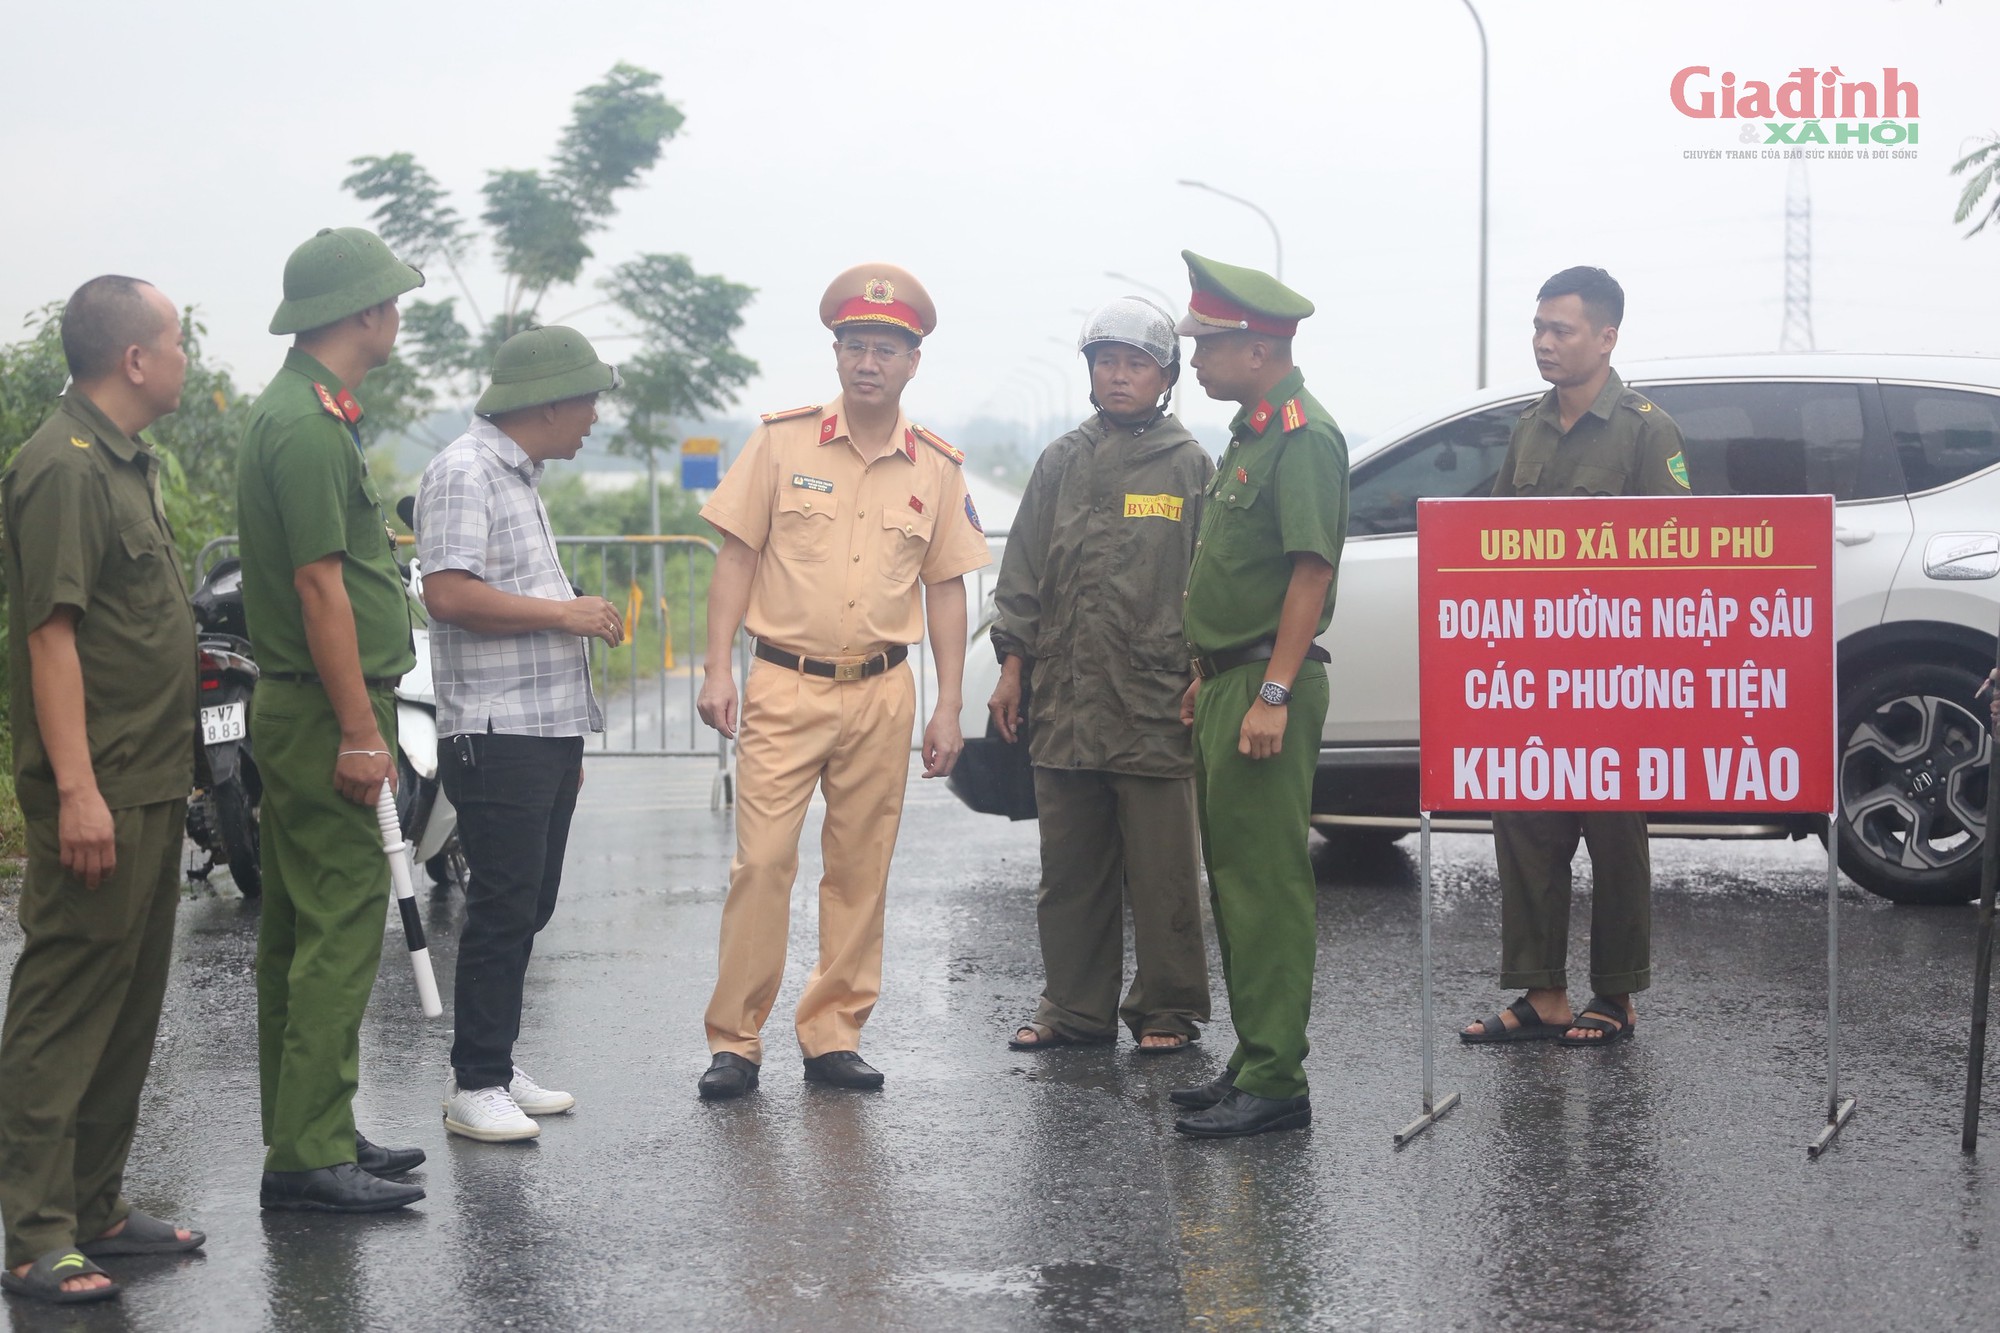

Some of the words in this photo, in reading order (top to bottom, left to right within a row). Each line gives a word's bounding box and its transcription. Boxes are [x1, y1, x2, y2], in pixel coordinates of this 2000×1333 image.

[1128, 502, 1182, 519] BVANTT
[1480, 528, 1566, 561] UBND
[1576, 521, 1619, 560] XÃ
[1628, 516, 1700, 559] KIỀU
[1710, 519, 1774, 558] PHÚ
[1437, 598, 1524, 648] ĐOẠN
[1533, 588, 1642, 639] ĐƯỜNG
[1652, 588, 1739, 647] NGẬP
[1749, 588, 1813, 638] SÂU
[1464, 660, 1535, 710] CÁC
[1547, 664, 1695, 710] PHƯƠNG
[1705, 659, 1787, 718] TIỆN
[1453, 735, 1621, 801] KHÔNG
[1636, 747, 1686, 801] ĐI
[1702, 735, 1800, 802] VÀO
